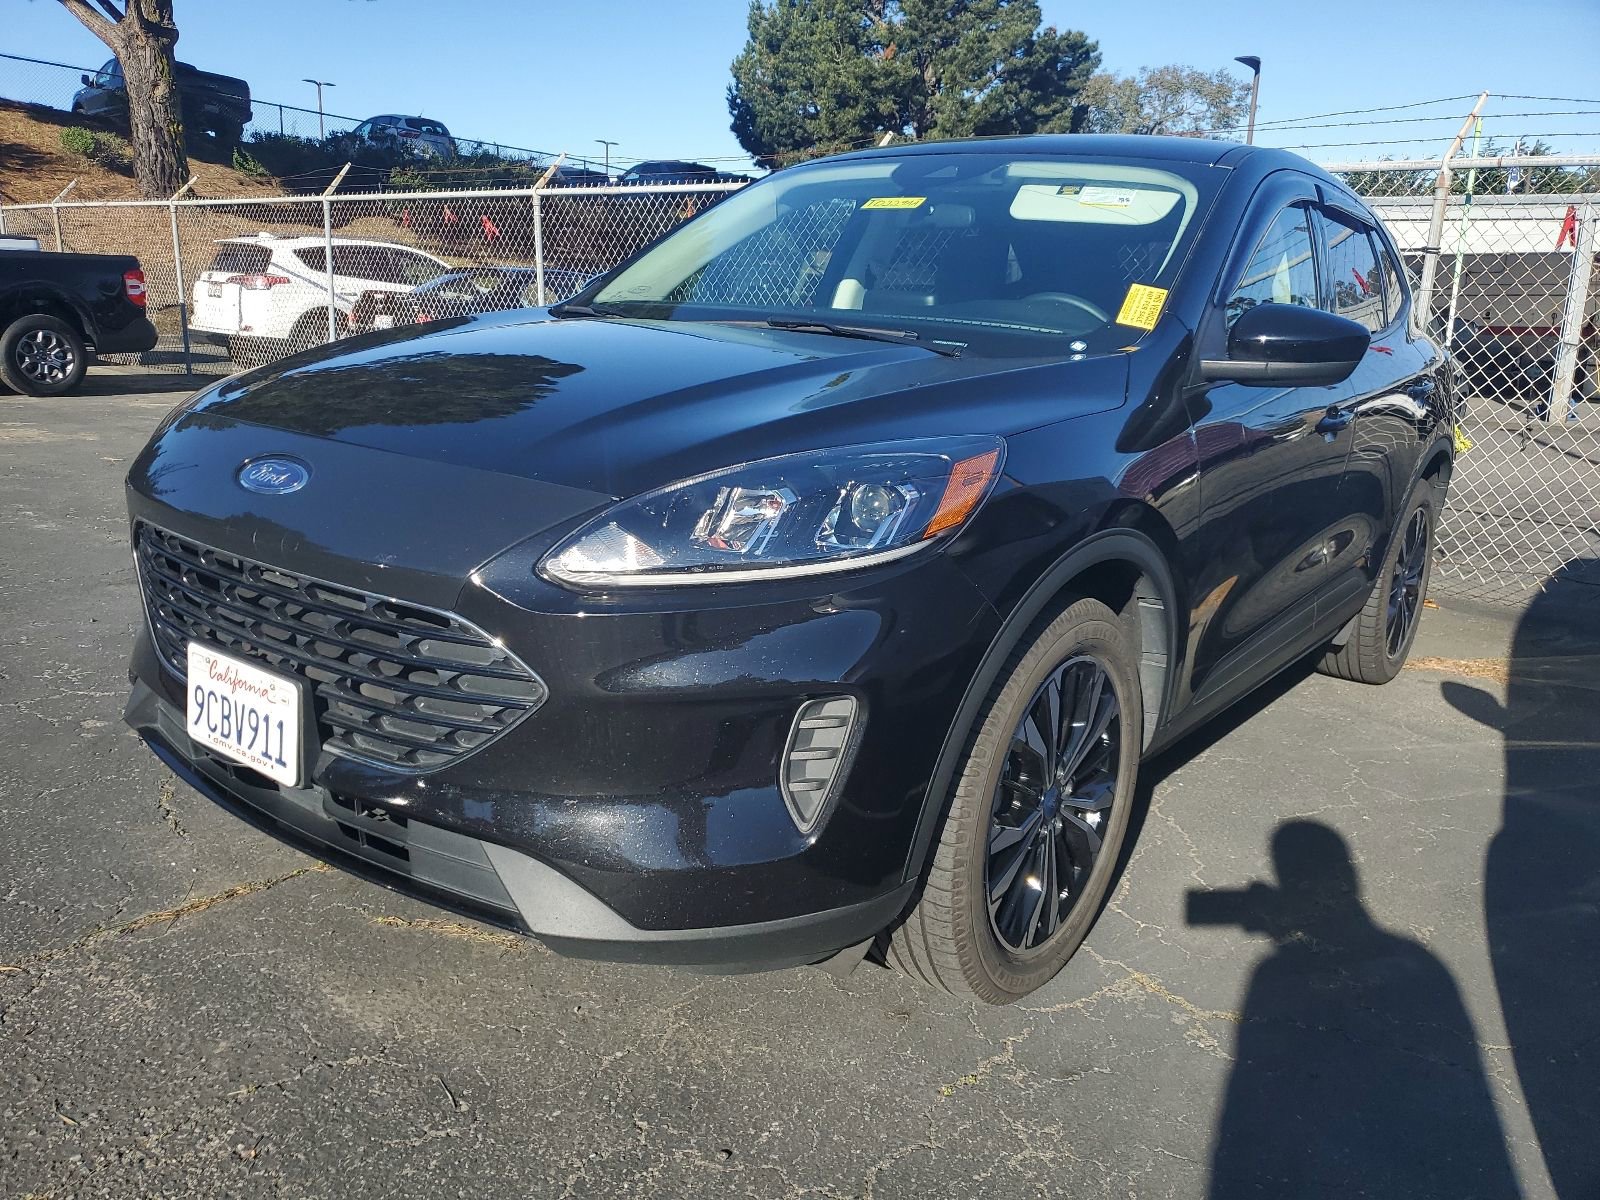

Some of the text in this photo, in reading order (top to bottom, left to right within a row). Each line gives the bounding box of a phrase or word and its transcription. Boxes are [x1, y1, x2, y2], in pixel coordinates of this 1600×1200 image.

[249, 463, 291, 485] Ford
[209, 659, 277, 704] California
[194, 684, 287, 768] 9CBV911
[213, 737, 268, 767] dmv.ca.gov
